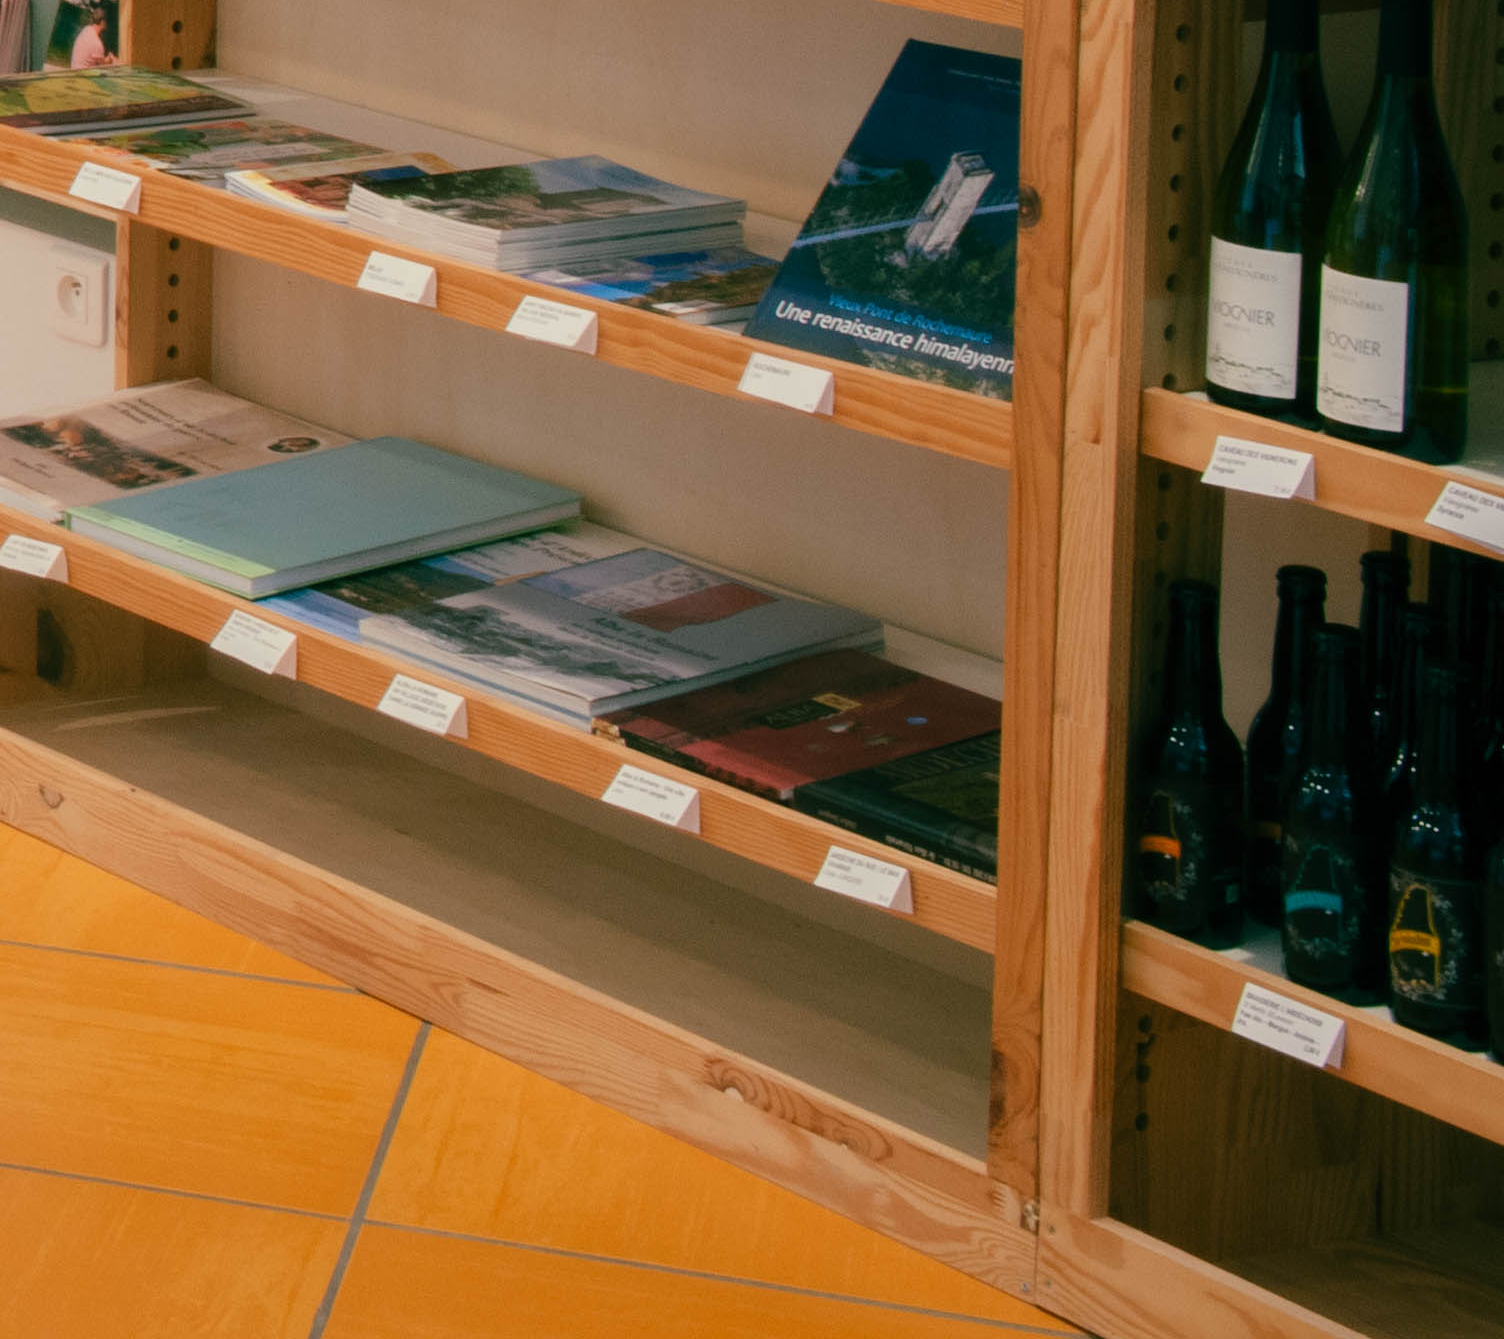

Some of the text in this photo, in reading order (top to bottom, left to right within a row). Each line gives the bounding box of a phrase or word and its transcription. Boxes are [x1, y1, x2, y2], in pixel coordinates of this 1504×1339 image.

[776, 300, 1015, 375] Une renaissance himalayenn
[830, 294, 993, 345] Vieux Pont de Rochemaure
